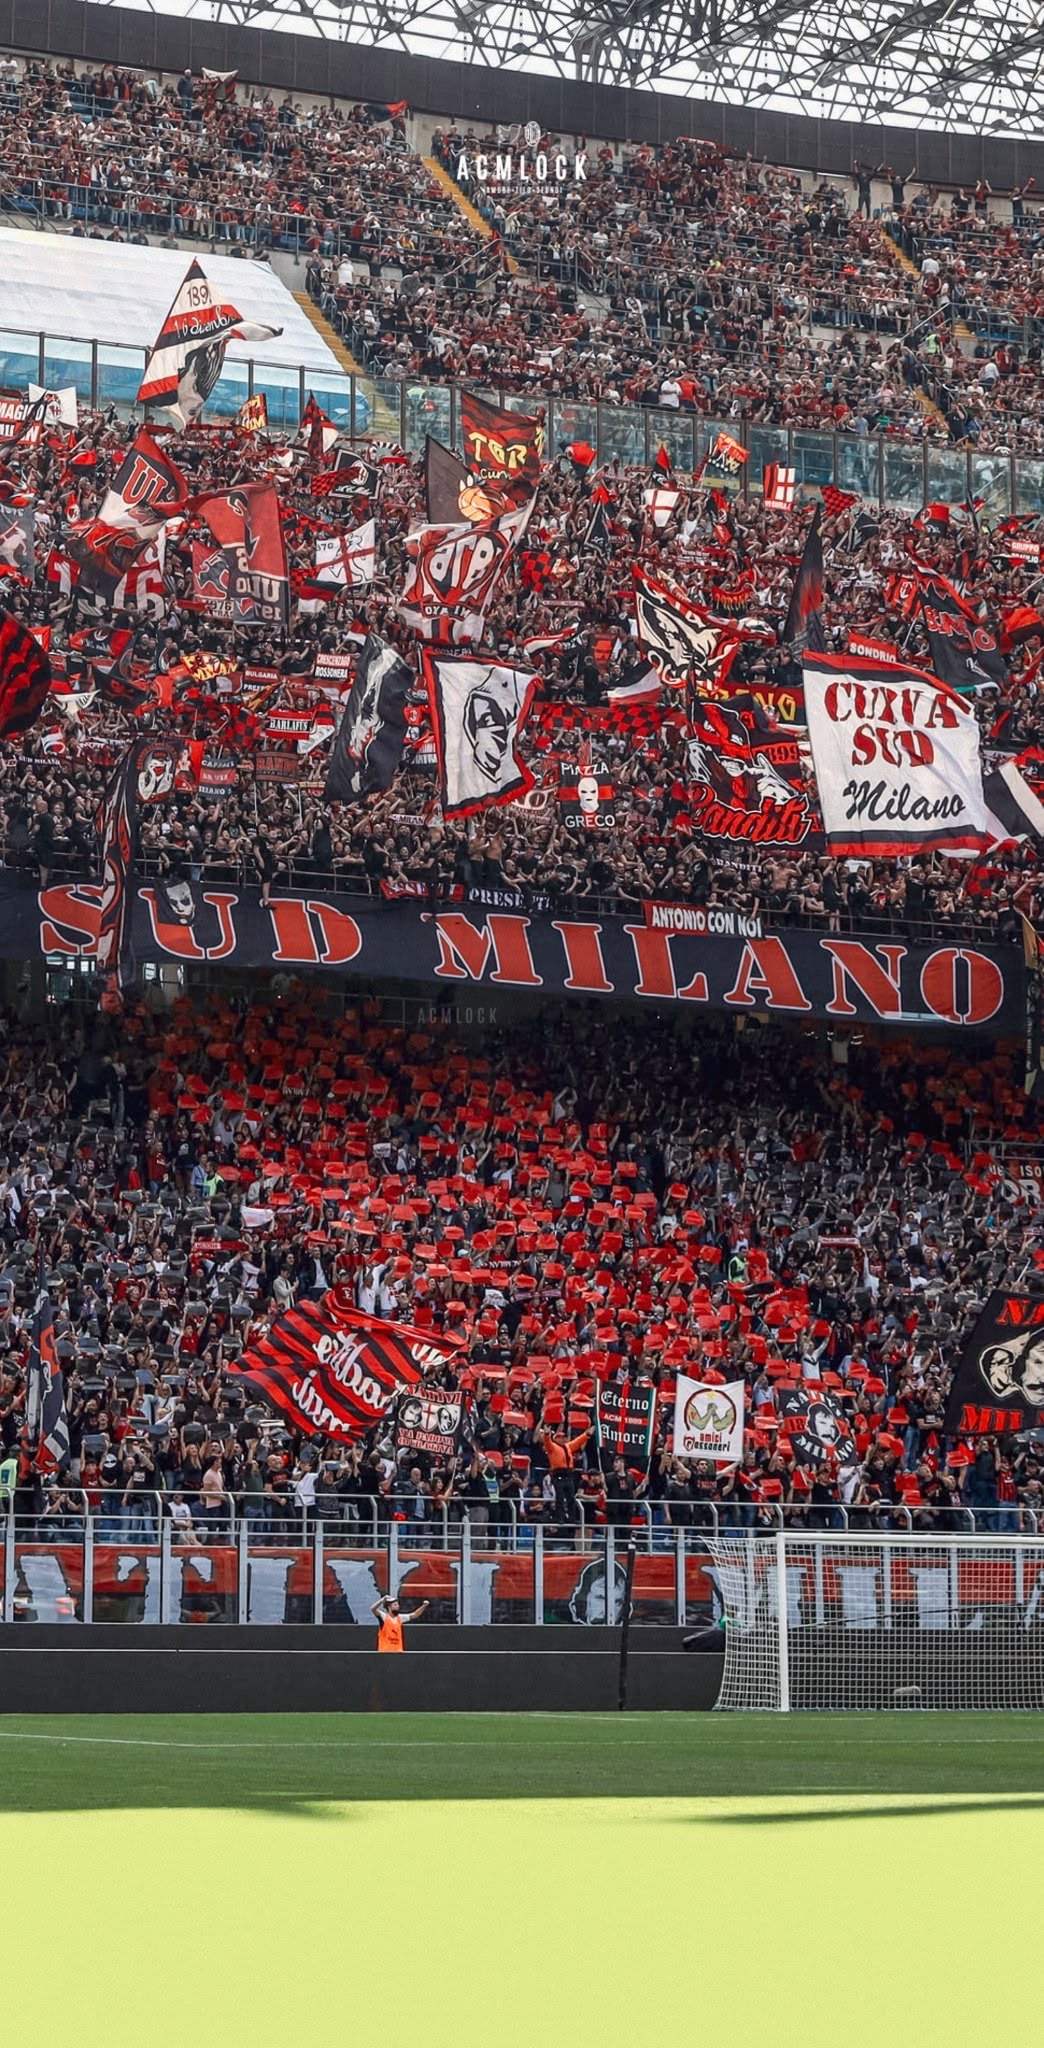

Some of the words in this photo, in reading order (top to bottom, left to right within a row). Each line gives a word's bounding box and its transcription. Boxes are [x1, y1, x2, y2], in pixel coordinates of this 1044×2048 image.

[850, 642, 897, 663] SONDRIO
[852, 723, 934, 768] SUD
[561, 762, 610, 776] PIAZZA
[842, 779, 966, 821] Milano
[564, 814, 616, 828] GRECO
[652, 906, 706, 932] ANTONIO
[707, 911, 735, 934] CON
[737, 914, 762, 938] NOI
[38, 884, 362, 964] SUD
[420, 911, 1004, 1025] MILANO
[600, 1389, 649, 1410] Eterno
[603, 1413, 622, 1423] ACM
[600, 1423, 646, 1445] Amore
[700, 1432, 722, 1443] amici
